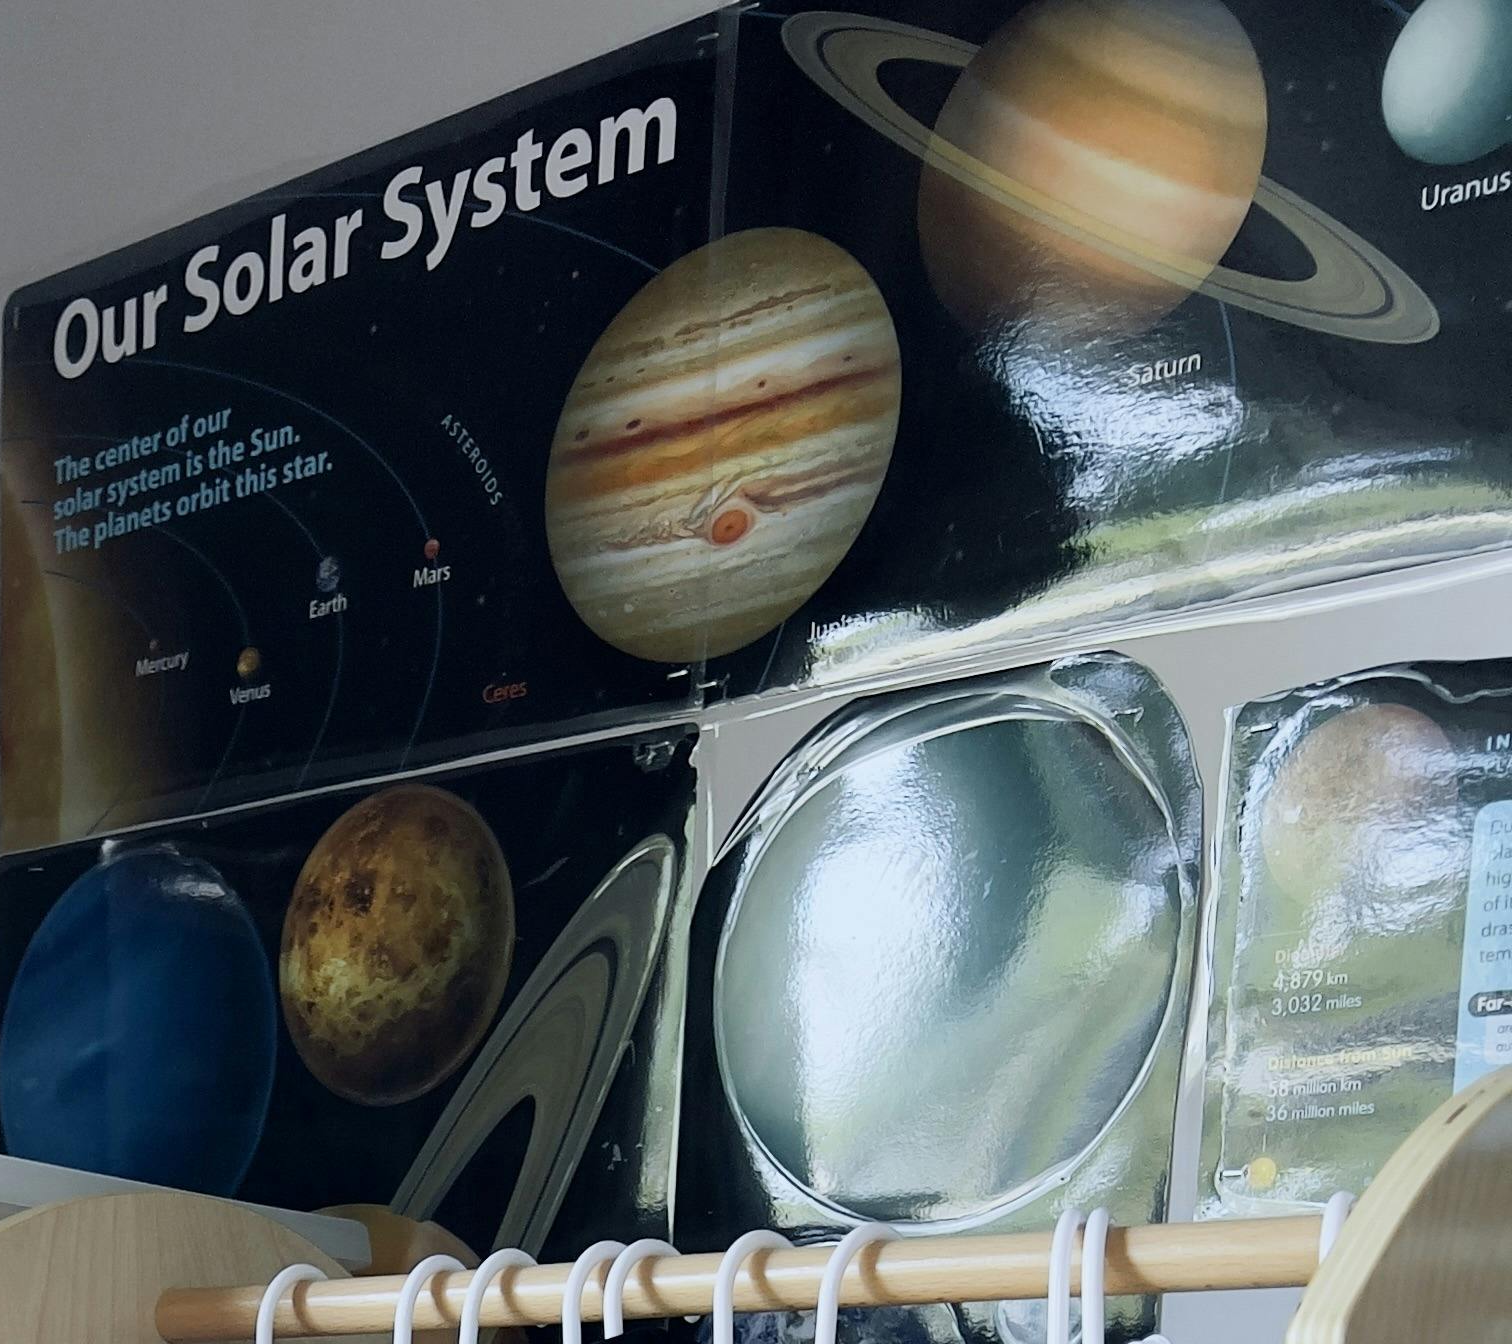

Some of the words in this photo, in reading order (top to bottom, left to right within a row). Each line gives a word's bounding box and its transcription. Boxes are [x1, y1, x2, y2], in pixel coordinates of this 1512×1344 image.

[1421, 170, 1511, 211] Uranus
[53, 282, 168, 379] Our
[184, 207, 364, 333] Solar
[380, 96, 677, 271] System
[1127, 353, 1201, 388] Saturn
[54, 455, 90, 485] The
[94, 431, 162, 472] center
[165, 414, 190, 447] of
[193, 407, 232, 438] our
[440, 413, 503, 506] ASTEROIDS
[54, 486, 105, 521] solar
[107, 462, 181, 507] system
[186, 450, 203, 478] is
[208, 439, 244, 470] the
[250, 425, 302, 457] Sun.
[53, 524, 90, 555] The
[94, 499, 172, 549] planets
[176, 477, 230, 516] orbit
[235, 463, 277, 499] this
[282, 451, 334, 485] star.
[413, 563, 451, 588] Mars
[308, 593, 348, 620] Earth
[134, 650, 190, 677] Mercury
[230, 682, 272, 705] Venus
[482, 680, 528, 704] Ceres
[1273, 969, 1324, 993] 4,879
[1327, 972, 1348, 985] km
[1271, 994, 1323, 1017] 3,032
[1326, 994, 1362, 1011] miles
[1267, 1053, 1334, 1072] Distance
[1340, 1050, 1377, 1064] from
[1268, 1080, 1289, 1098] 58
[1293, 1079, 1336, 1095] million
[1340, 1077, 1361, 1091] km
[1265, 1104, 1288, 1122] 36
[1291, 1103, 1335, 1119] million
[1338, 1101, 1375, 1116] miles
